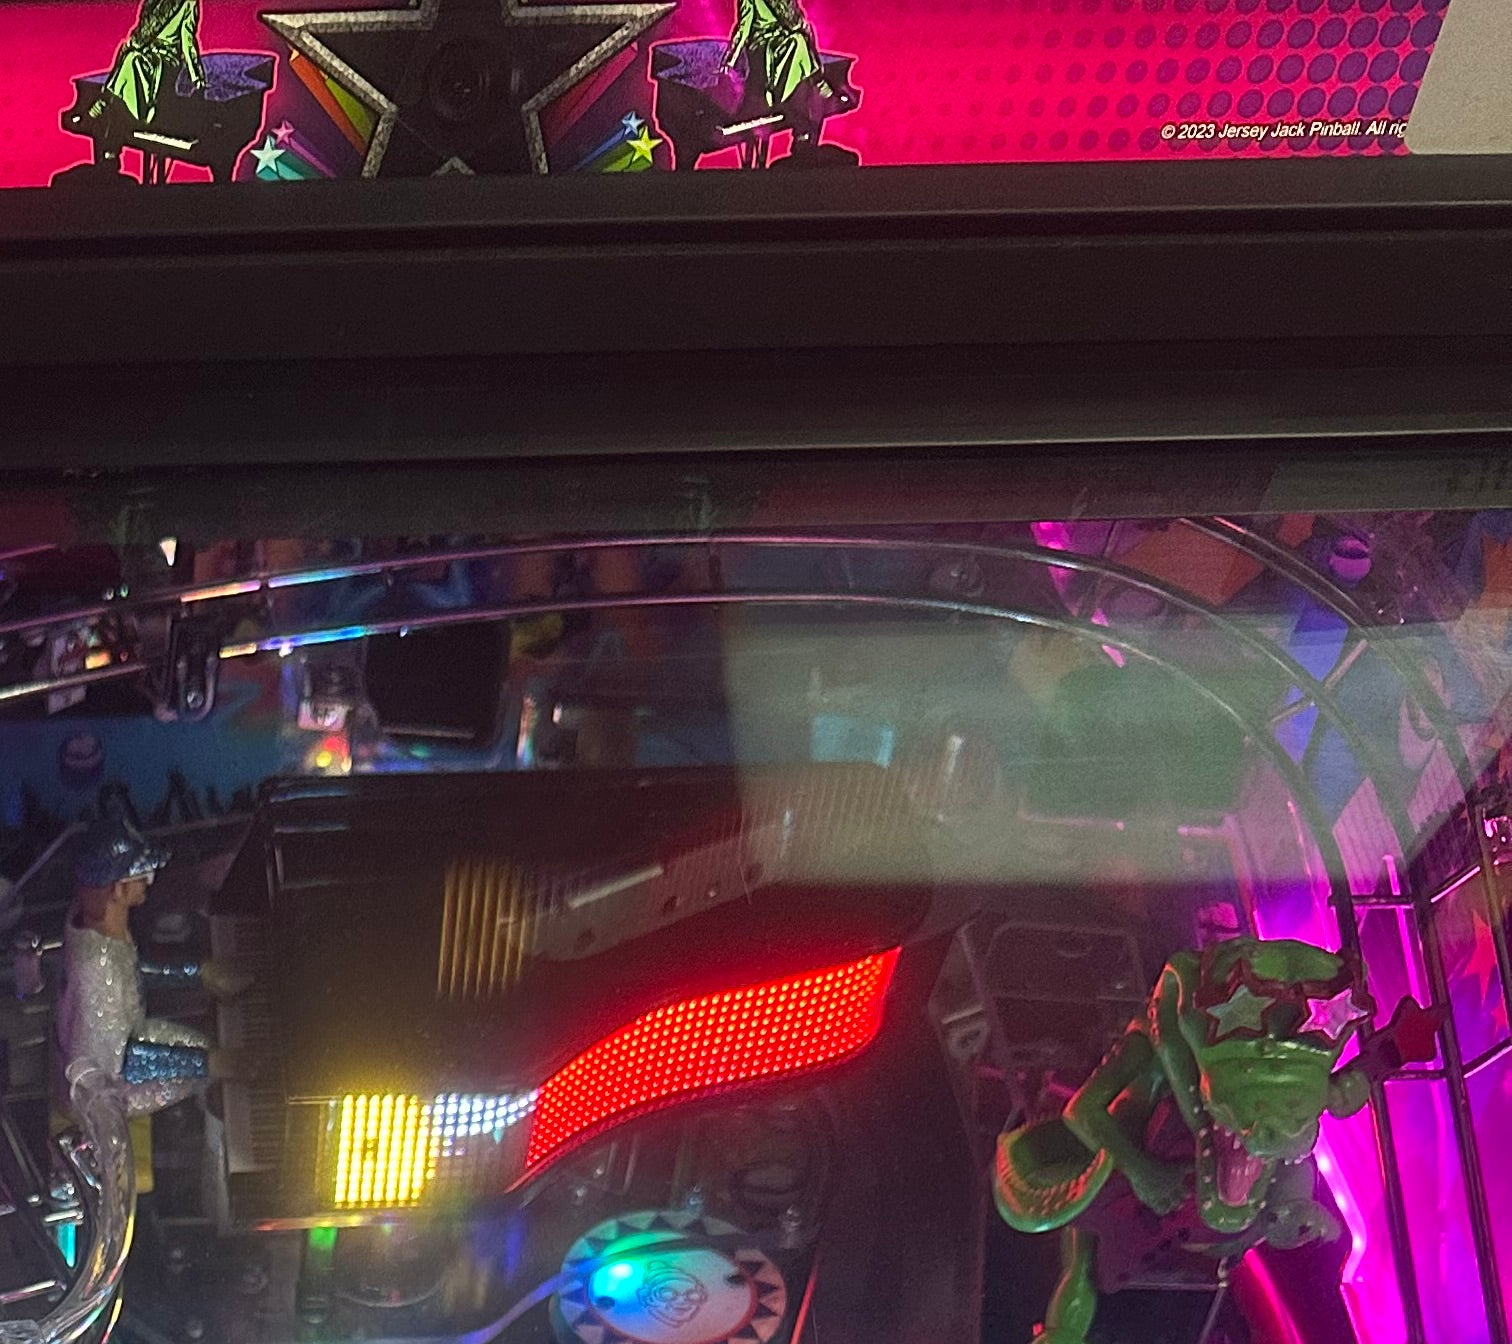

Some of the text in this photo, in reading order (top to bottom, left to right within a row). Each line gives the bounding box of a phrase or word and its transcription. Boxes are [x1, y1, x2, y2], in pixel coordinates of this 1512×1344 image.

[1178, 124, 1215, 139] 2023
[1218, 122, 1268, 141] Jersey
[1271, 121, 1304, 138] Jack
[1365, 120, 1387, 136] All
